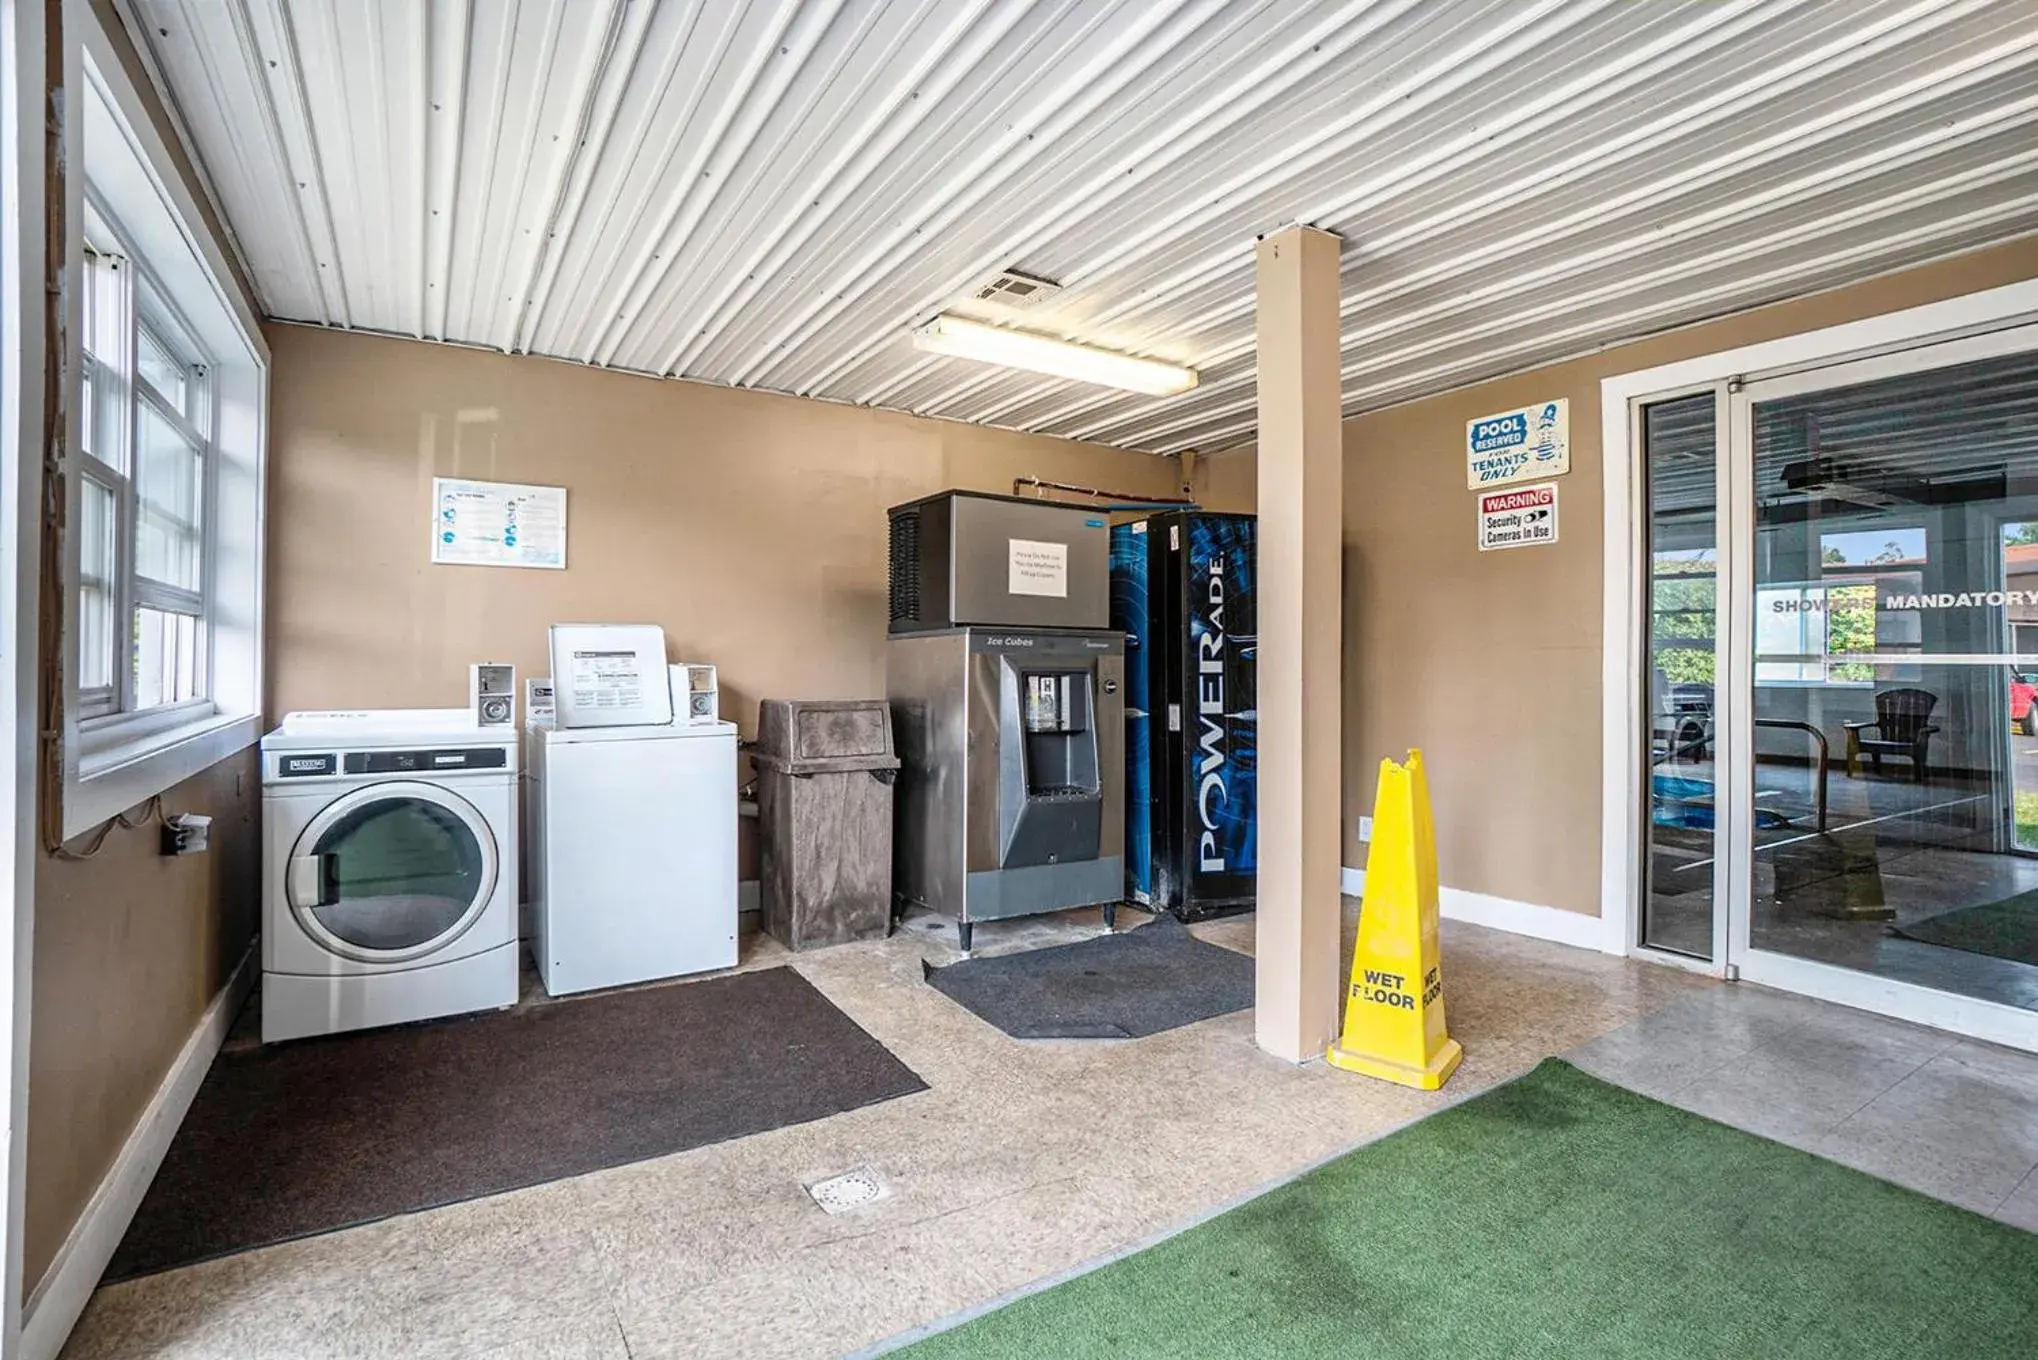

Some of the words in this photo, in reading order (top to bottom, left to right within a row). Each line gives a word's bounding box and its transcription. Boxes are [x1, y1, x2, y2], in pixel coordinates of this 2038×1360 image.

[1478, 418, 1522, 439] POOL
[1475, 432, 1522, 451] RESERVED
[1472, 452, 1529, 473] TENANTS
[1480, 465, 1521, 482] ONLY
[1486, 490, 1551, 511] WARNING
[1487, 515, 1522, 529] Security
[1487, 530, 1521, 543] Cameras
[1523, 527, 1532, 539] In
[1533, 525, 1549, 538] Use
[1886, 590, 2038, 610] MANDATORY
[987, 637, 1003, 645] Ice
[1004, 637, 1033, 646] Cubes
[1199, 551, 1228, 873] POWERADE
[1363, 969, 1405, 990] WET
